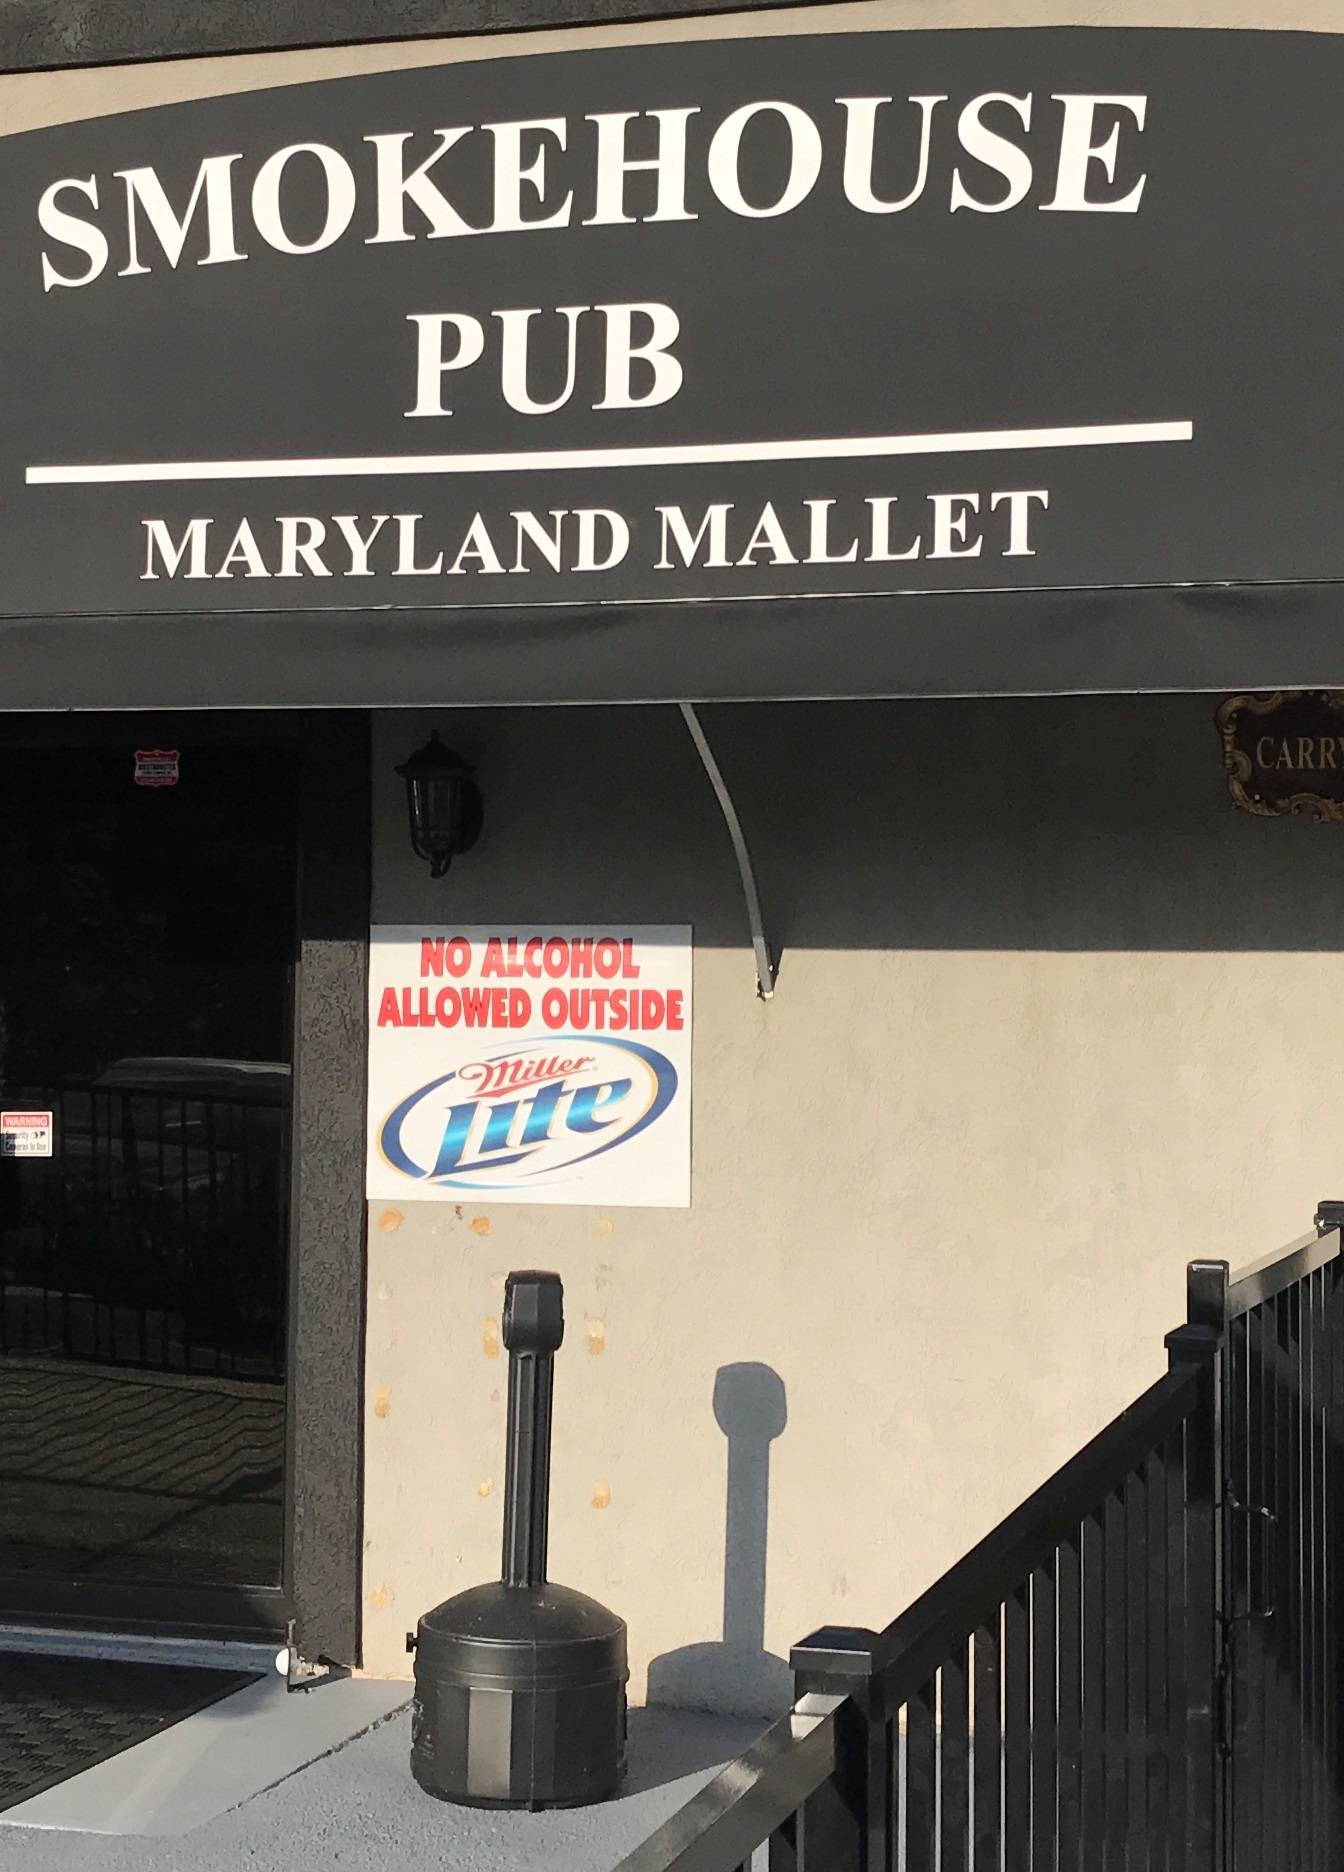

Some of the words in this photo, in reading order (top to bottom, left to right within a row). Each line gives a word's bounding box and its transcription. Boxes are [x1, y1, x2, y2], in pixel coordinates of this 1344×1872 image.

[37, 92, 1151, 293] SMOKEHOUSE
[403, 301, 684, 418] PUB
[138, 506, 631, 581] MARYLAND
[653, 489, 1050, 571] MALLET
[419, 936, 472, 978] NO
[480, 936, 641, 980] ALCOHOL
[377, 986, 532, 1029] ALLOWED
[541, 988, 684, 1031] OUTSIDE
[458, 1055, 596, 1099] Miller
[3, 1116, 48, 1127] WARNING
[423, 1077, 634, 1182] Lite
